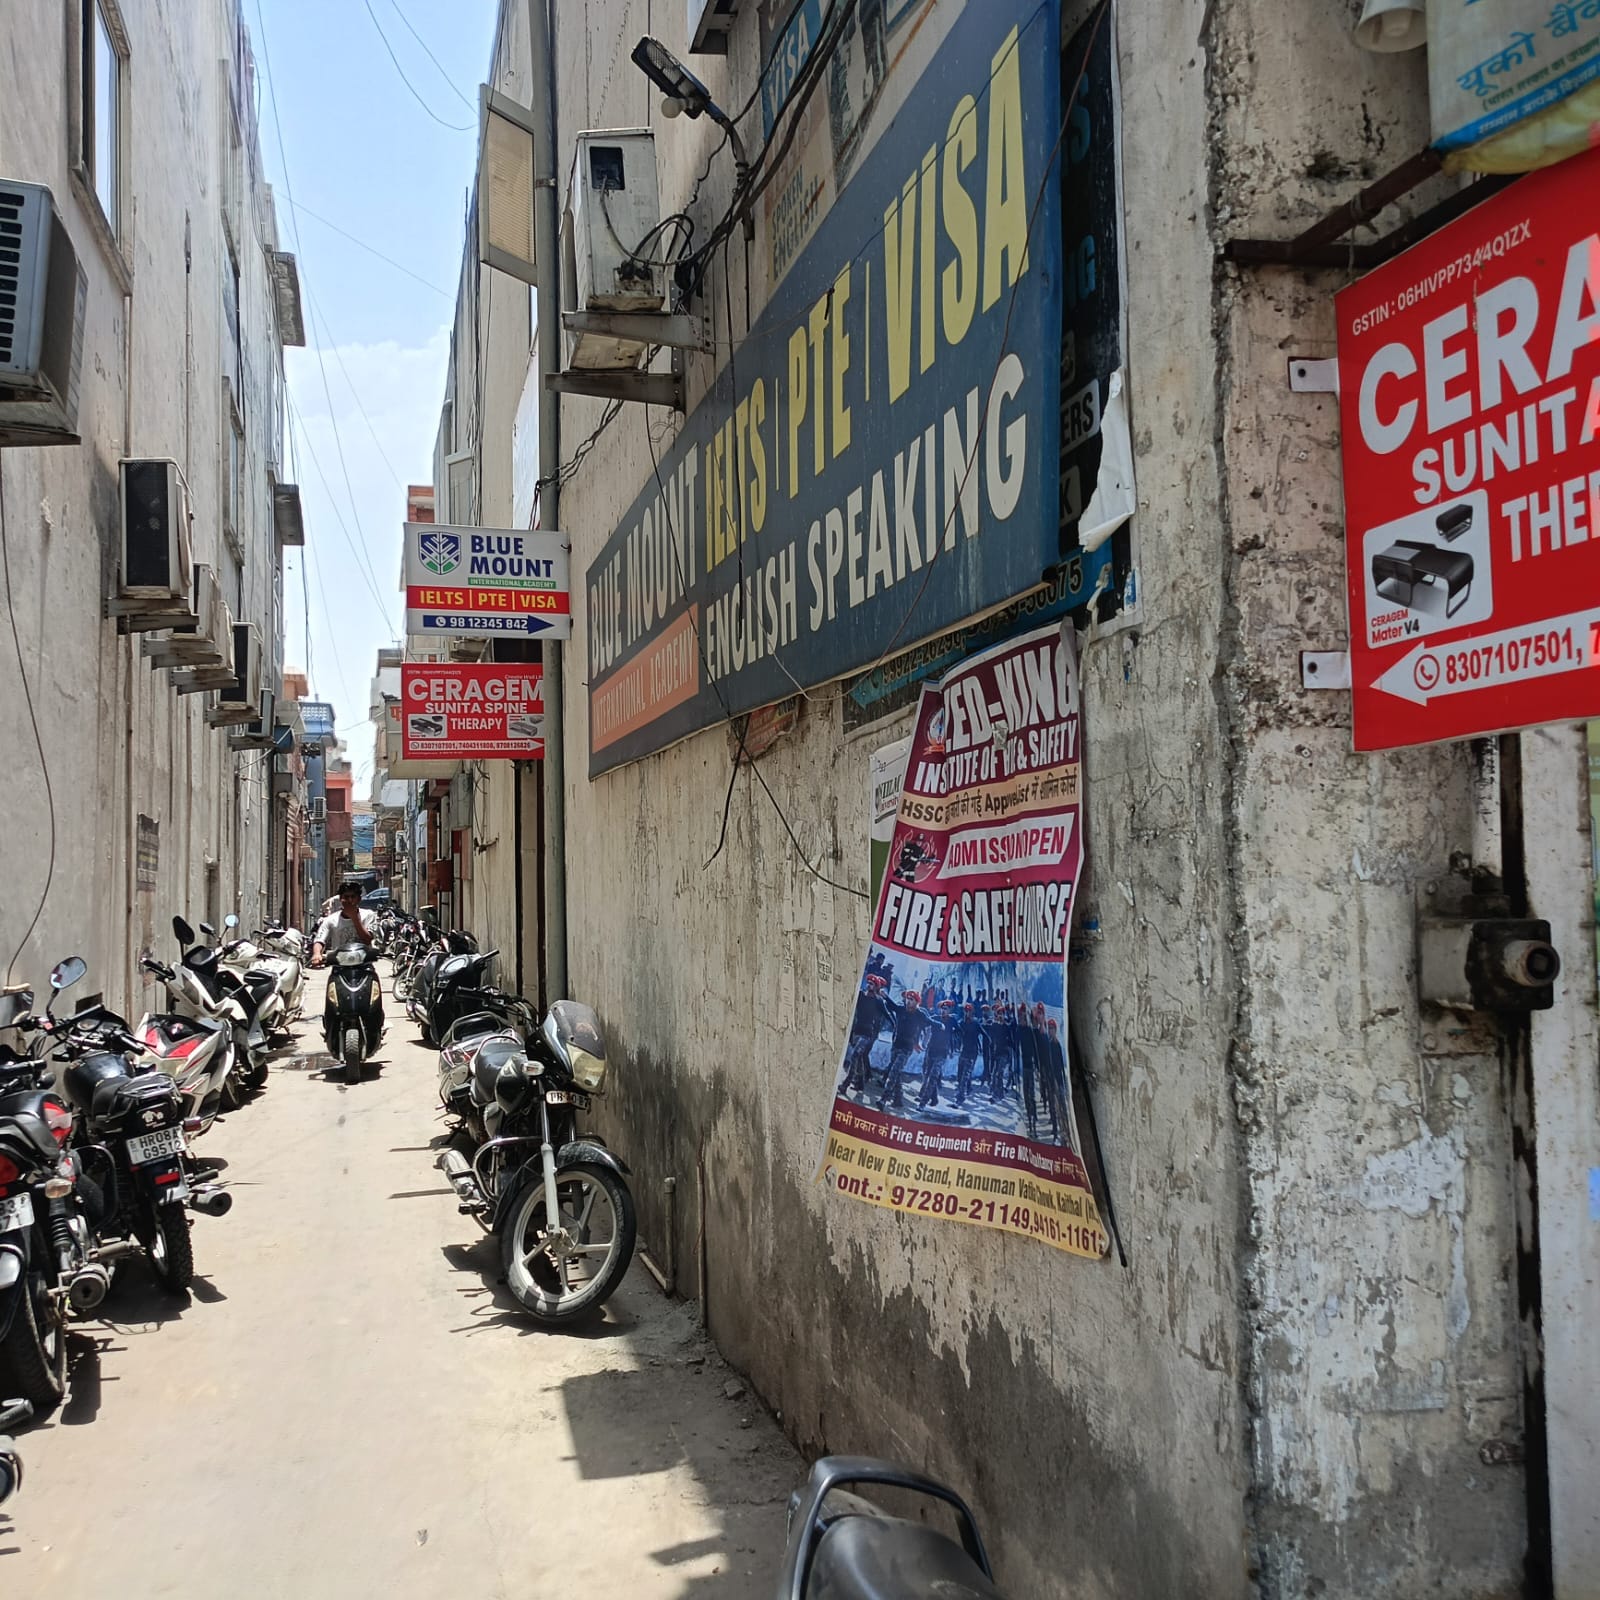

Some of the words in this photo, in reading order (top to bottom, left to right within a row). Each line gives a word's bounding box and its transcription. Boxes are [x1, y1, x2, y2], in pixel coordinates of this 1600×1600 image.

[1456, 31, 1536, 97] यूको
[590, 551, 622, 680] BLUE
[626, 442, 699, 647] MOUNT
[705, 377, 767, 574] IELTS
[787, 261, 851, 499] PTE
[884, 23, 1030, 405] VISA
[706, 541, 798, 685] ENGLISH
[807, 352, 1027, 633] SPEAKING
[471, 534, 524, 555] BLUE
[470, 556, 554, 577] MOUNT
[523, 580, 554, 588] ACADEMY
[420, 590, 464, 605] IELTS
[478, 592, 507, 607] PTE
[520, 594, 557, 609] VISA
[1371, 607, 1409, 628] CERAGEM
[1404, 618, 1420, 636] V4
[649, 625, 695, 708] ACADEMY
[408, 679, 544, 701] CERAGEM
[425, 702, 482, 714] SUNITA
[485, 702, 528, 714] SPINE
[450, 717, 503, 730] THERAPY
[980, 745, 997, 781] OF
[1028, 719, 1078, 768] SAFETY
[901, 798, 943, 825] HSSC
[879, 883, 948, 954] FIRE
[948, 903, 962, 955] &
[1016, 882, 1072, 955] COURSE
[835, 1110, 853, 1128] सभी
[853, 1115, 877, 1137] प्रकार
[878, 1122, 888, 1138] के
[889, 1125, 913, 1145] Fire
[915, 1130, 972, 1153] Equipment
[973, 1137, 993, 1156] और
[994, 1142, 1016, 1160] Fire
[828, 1137, 855, 1163] Near
[857, 1149, 883, 1173] New
[886, 1156, 910, 1179] Bus
[914, 1162, 952, 1189] Stand,
[955, 1168, 1015, 1197] Hanuman
